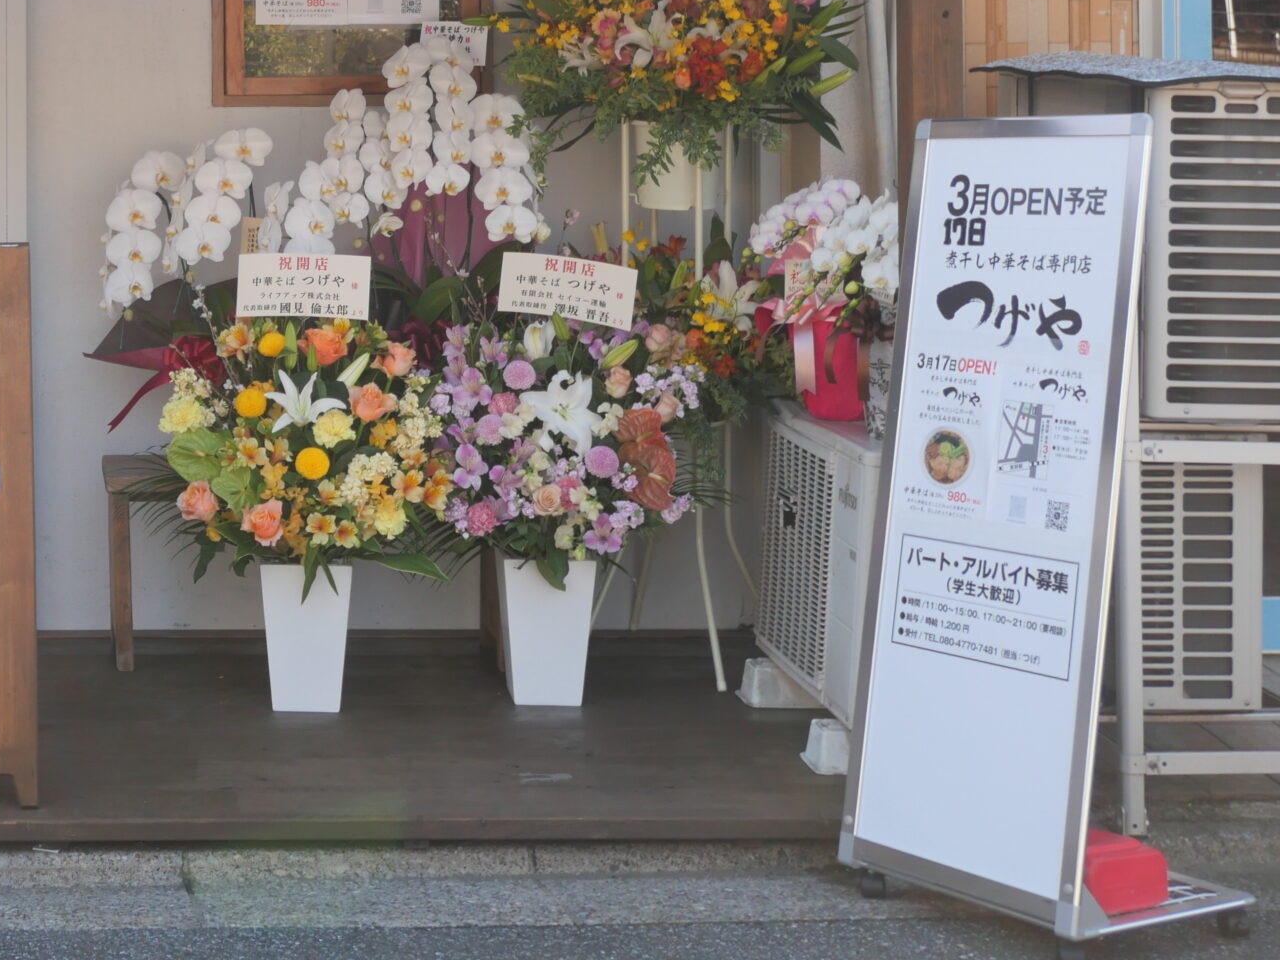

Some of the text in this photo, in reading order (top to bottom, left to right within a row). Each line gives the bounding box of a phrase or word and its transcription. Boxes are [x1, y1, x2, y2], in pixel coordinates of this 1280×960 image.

[307, 0, 325, 7] 980
[947, 174, 1107, 217] 3月OPEN予定
[943, 217, 986, 246] 17日
[279, 256, 329, 271] 祝開店
[545, 258, 596, 277] 祝開店
[945, 251, 1092, 274] 煮干し中華そば専門店
[252, 276, 295, 287] 中華そば
[302, 274, 345, 287] つげや
[516, 274, 561, 287] 中華そば
[567, 280, 611, 295] つげや
[259, 291, 340, 301] ライフアップ株式会社
[936, 280, 1082, 351] つげや
[917, 353, 997, 376] 3月17日OPEN!
[942, 386, 981, 407] つげや
[1038, 378, 1087, 403] つげや
[947, 490, 967, 503] 980
[907, 547, 1069, 594] パート・アルバイト募集
[946, 577, 1021, 606] (学生大歓迎)
